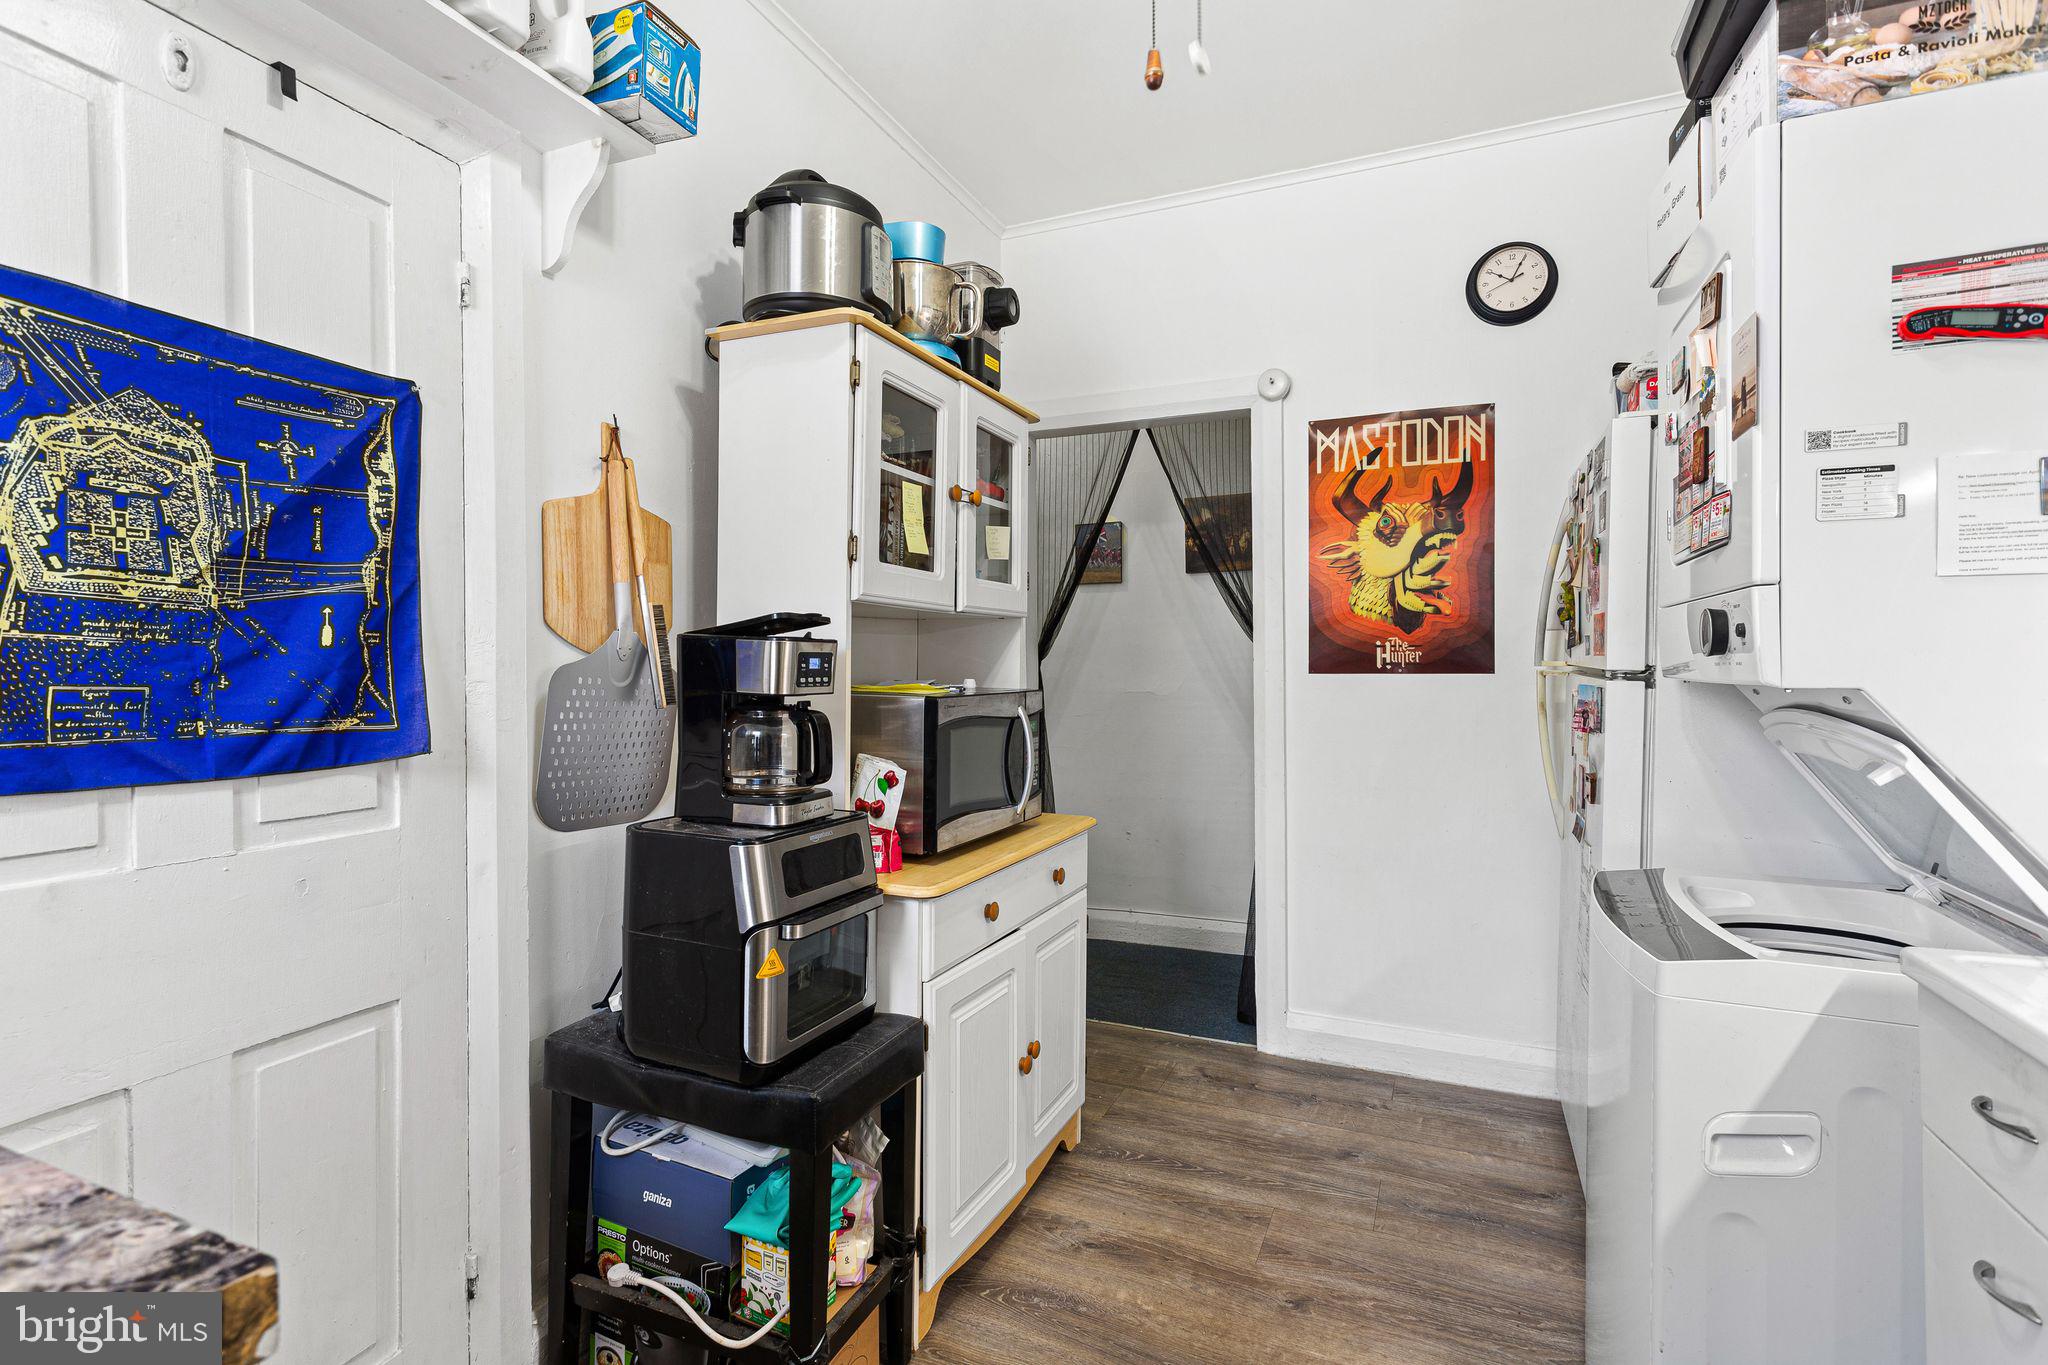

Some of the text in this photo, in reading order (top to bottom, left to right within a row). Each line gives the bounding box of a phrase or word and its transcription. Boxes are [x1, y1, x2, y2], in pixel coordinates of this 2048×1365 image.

[1844, 49, 1891, 67] Pasta
[1898, 45, 1911, 57] &
[1918, 32, 1979, 53] Ravioli
[1494, 258, 1502, 266] 11
[1963, 256, 1983, 264] MEAT
[1983, 247, 2036, 261] TEMPERATURE
[1316, 413, 1486, 474] MASTODON
[1376, 636, 1423, 670] The Hunter
[643, 1189, 673, 1208] ganiza
[597, 1225, 627, 1242] PRESTO
[632, 1239, 670, 1264] Options
